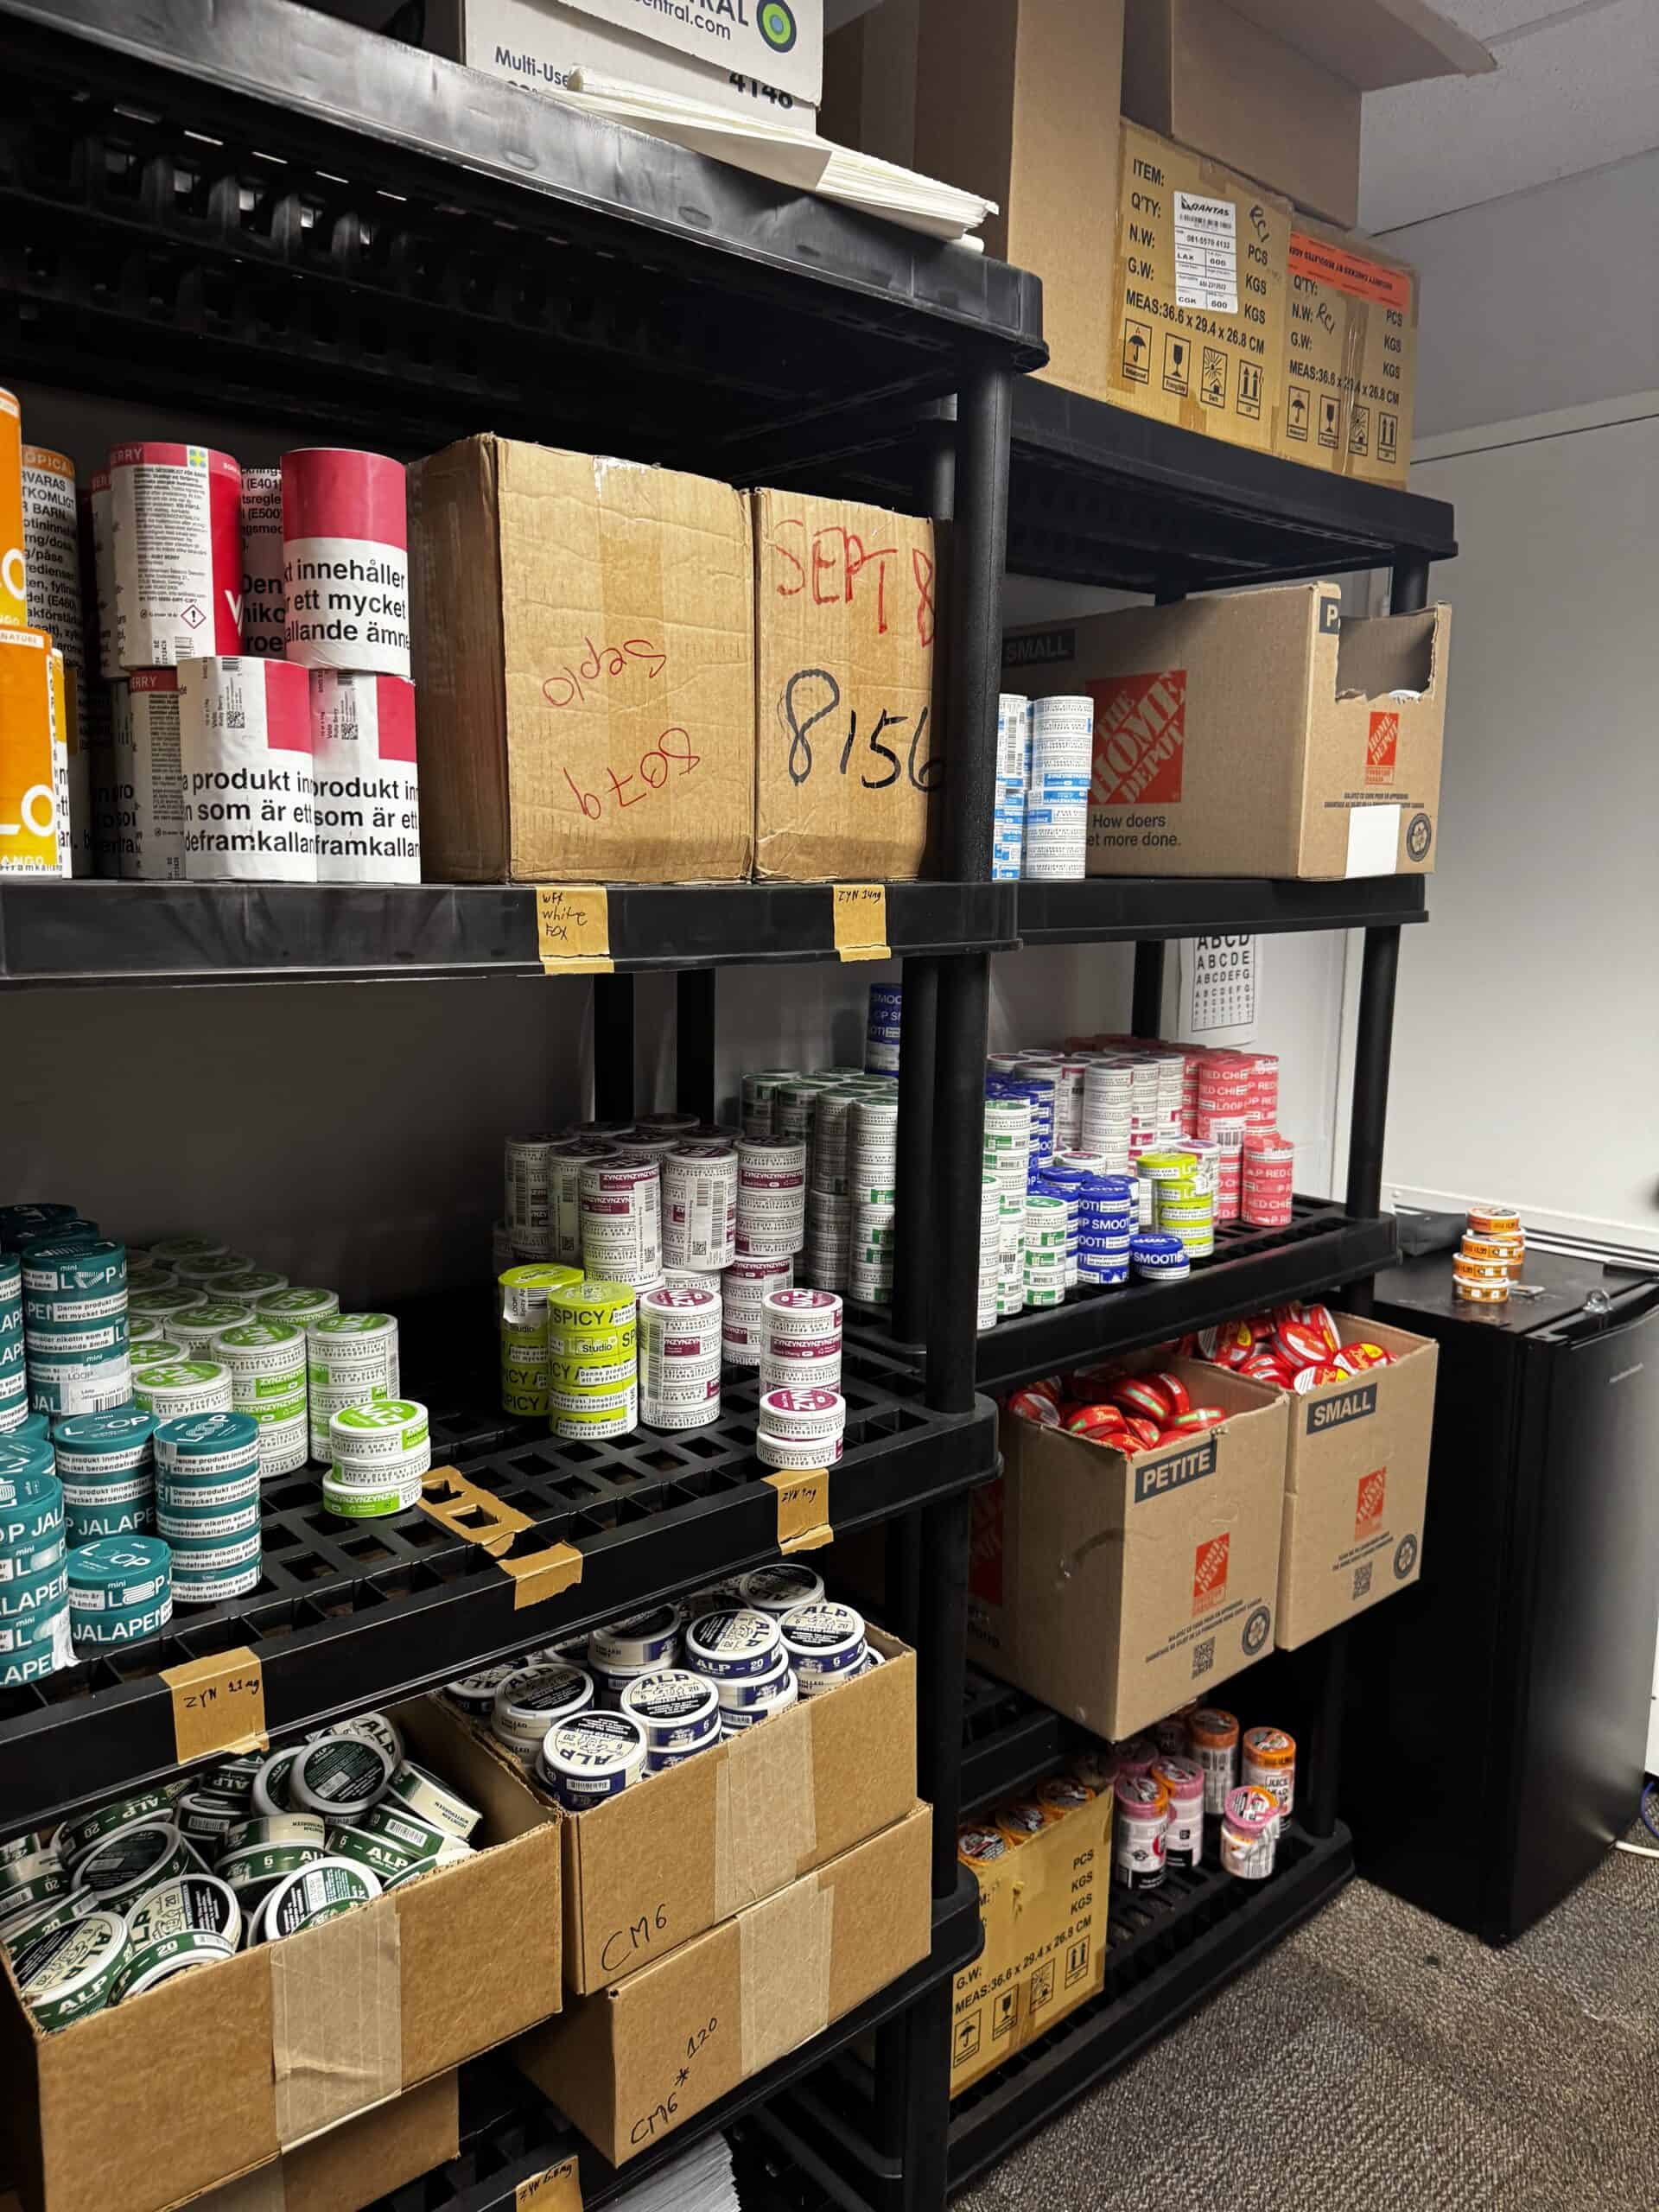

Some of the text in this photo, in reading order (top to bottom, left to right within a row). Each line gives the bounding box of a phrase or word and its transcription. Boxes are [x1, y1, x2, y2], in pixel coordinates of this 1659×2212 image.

[1133, 158, 1165, 187] ITEM:
[1131, 192, 1161, 219] Q'TY:
[1129, 223, 1155, 249] N.W:
[1248, 244, 1268, 266] PCS
[1128, 257, 1154, 281] G.W:
[1246, 273, 1267, 296] KGS
[1126, 289, 1185, 324] MEAS:36.6
[1195, 315, 1216, 337] 29.4
[1227, 327, 1247, 348] 26.8
[1249, 338, 1265, 356] CM
[1244, 303, 1266, 325] KGS
[1292, 303, 1313, 323] N.W:
[1386, 309, 1403, 327] PCS
[1291, 332, 1313, 350] G.W:
[1384, 334, 1402, 353] KGS
[1382, 361, 1401, 379] KGS
[297, 558, 405, 590] innehåller
[774, 518, 899, 635] SEPT
[328, 593, 406, 620] mycket
[193, 768, 291, 796] produkt
[198, 802, 251, 822] som
[260, 800, 287, 822] är
[314, 810, 363, 827] som
[372, 807, 396, 828] är
[1092, 813, 1166, 829] How doers
[1103, 832, 1140, 847] more
[1142, 831, 1182, 847] done.
[553, 1308, 605, 1325] SPICY
[582, 1342, 613, 1353] Studio
[1314, 1396, 1371, 1427] SMALL
[1142, 1452, 1211, 1494] PETITE
[16, 1545, 35, 1556] mini
[108, 1580, 126, 1589] mini
[16, 1617, 35, 1627] mini
[804, 1605, 849, 1618] ALP
[695, 1659, 765, 1673] ALP 20
[641, 1673, 690, 1689] ALP
[558, 1748, 613, 1766] ALP
[366, 1846, 409, 1871] ALP
[1072, 1849, 1094, 1870] PCS
[1071, 1872, 1093, 1893] KGS
[1071, 1893, 1092, 1915] KGS
[1075, 1916, 1092, 1934] CM
[156, 1940, 179, 1958] 20
[957, 1966, 982, 1990] G.W:
[58, 1974, 109, 2015] ALP
[631, 2092, 678, 2144] CM6
